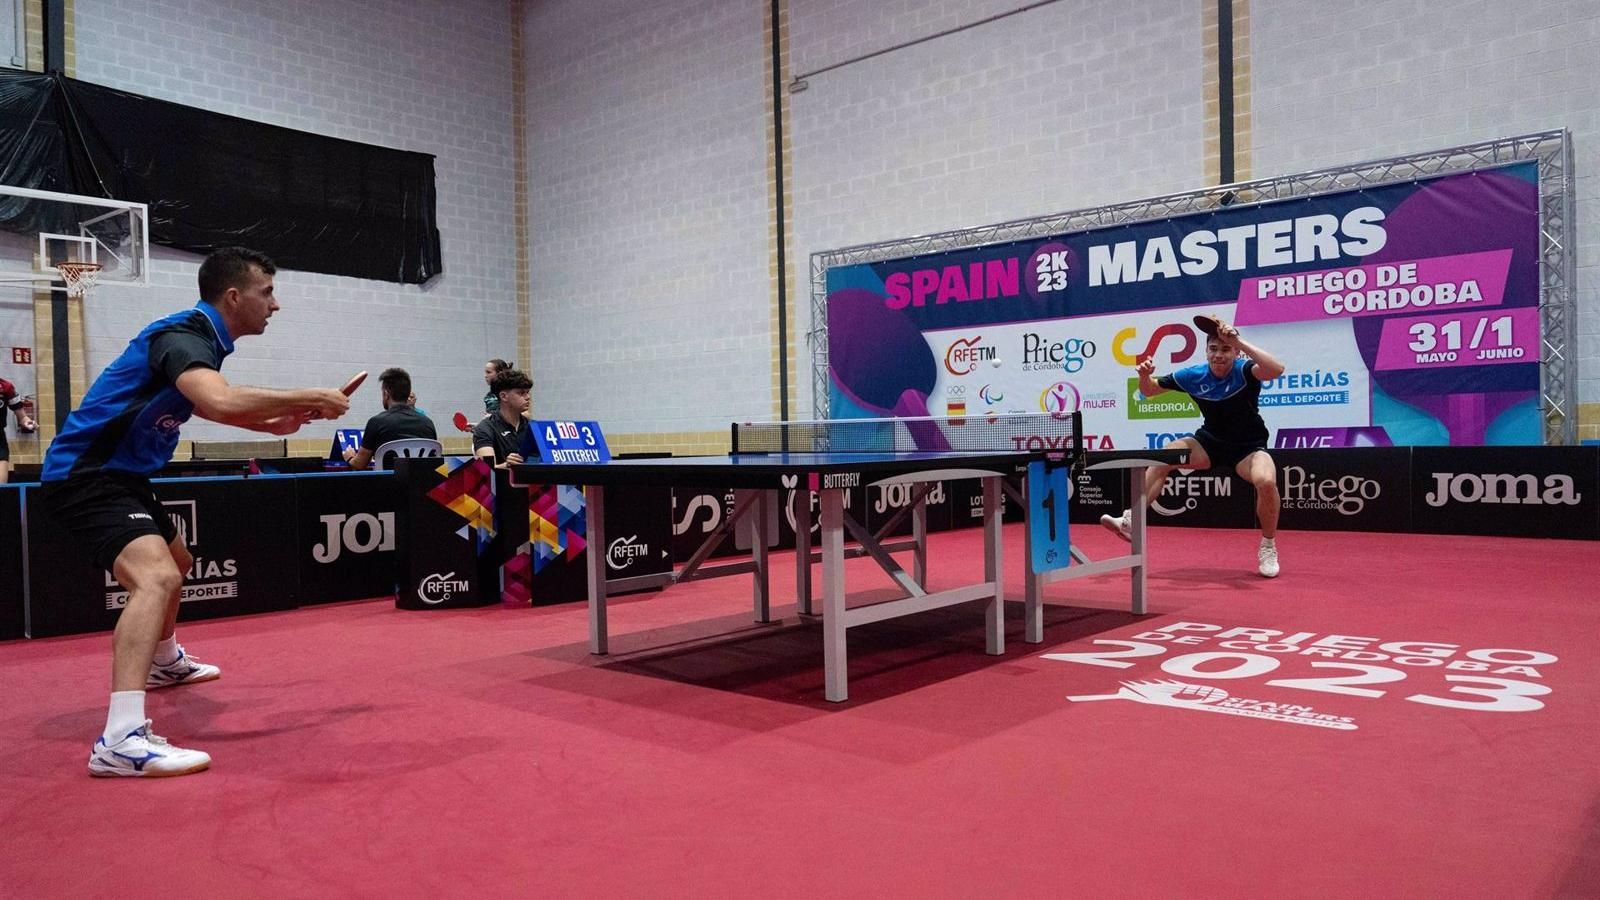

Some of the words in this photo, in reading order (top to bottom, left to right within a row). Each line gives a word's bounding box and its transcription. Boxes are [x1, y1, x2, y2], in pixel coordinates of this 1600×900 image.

[1088, 206, 1387, 287] MASTERS
[1036, 251, 1069, 273] 2K
[885, 257, 1019, 310] SPAIN
[1037, 270, 1068, 292] 23
[1257, 268, 1367, 299] PRIEGO
[1376, 263, 1417, 287] DE
[1323, 280, 1483, 315] CORDOBA
[953, 346, 996, 363] RFETM
[1022, 333, 1096, 373] Priego
[1416, 352, 1457, 363] MAYO
[1476, 347, 1524, 360] JUNIO
[1023, 363, 1031, 372] de
[1083, 399, 1116, 409] MUJER
[1138, 402, 1195, 413] IBERDROLA
[1281, 396, 1292, 404] EL
[1295, 393, 1342, 403] DEPORTE
[546, 426, 557, 446] 4
[585, 427, 596, 446] 3
[552, 449, 600, 462] BUTTERFLY
[824, 473, 861, 489] BUTTERFLY
[1161, 477, 1231, 497] RFETM
[1282, 465, 1381, 516] Priego
[1283, 501, 1294, 509] de
[1297, 499, 1338, 510] Córdoba
[1042, 489, 1056, 542] 1
[614, 544, 648, 558] RFETM
[428, 579, 469, 593] RFETM
[1156, 621, 1559, 665] PRIEGO
[1132, 631, 1211, 645] DE
[1218, 640, 1543, 678] CORDOBA
[1039, 639, 1553, 712] 2023
[1216, 702, 1356, 723] MASTERS
[1224, 697, 1313, 712] SPAIN
